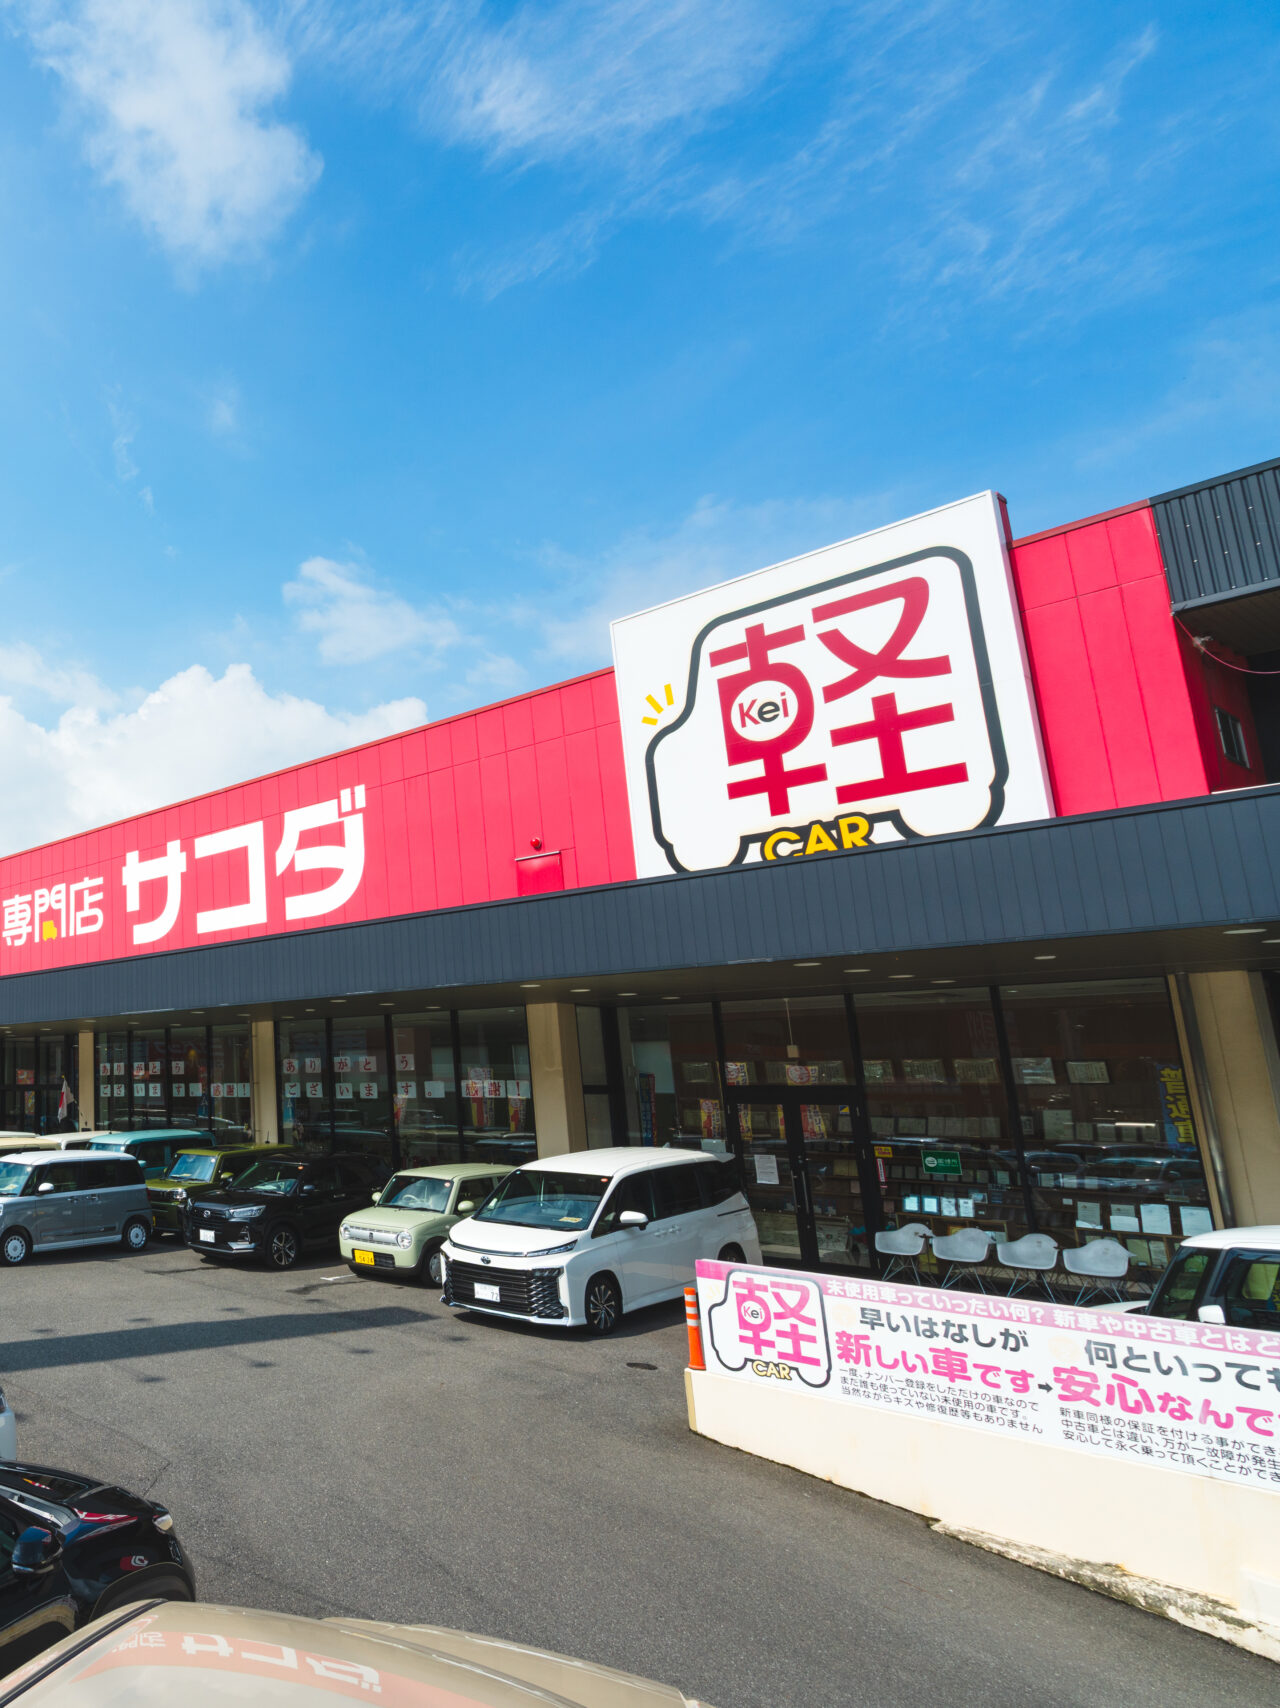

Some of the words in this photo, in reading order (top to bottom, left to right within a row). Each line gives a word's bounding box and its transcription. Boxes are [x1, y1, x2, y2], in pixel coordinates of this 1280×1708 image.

[708, 576, 969, 817] 軽
[738, 691, 788, 729] Kei
[121, 783, 367, 945] サコダ
[763, 814, 872, 861] CAR
[732, 1277, 822, 1367] 軽
[743, 1305, 764, 1320] Kei
[826, 1279, 1045, 1323] 未使用車っていったい何？
[1053, 1309, 1252, 1352] 新車や中古車とは
[859, 1306, 1030, 1352] 早いはなしが
[751, 1359, 793, 1381] CAR
[834, 1330, 1035, 1394] 新しい車です
[1052, 1366, 1280, 1437] 安心なんで
